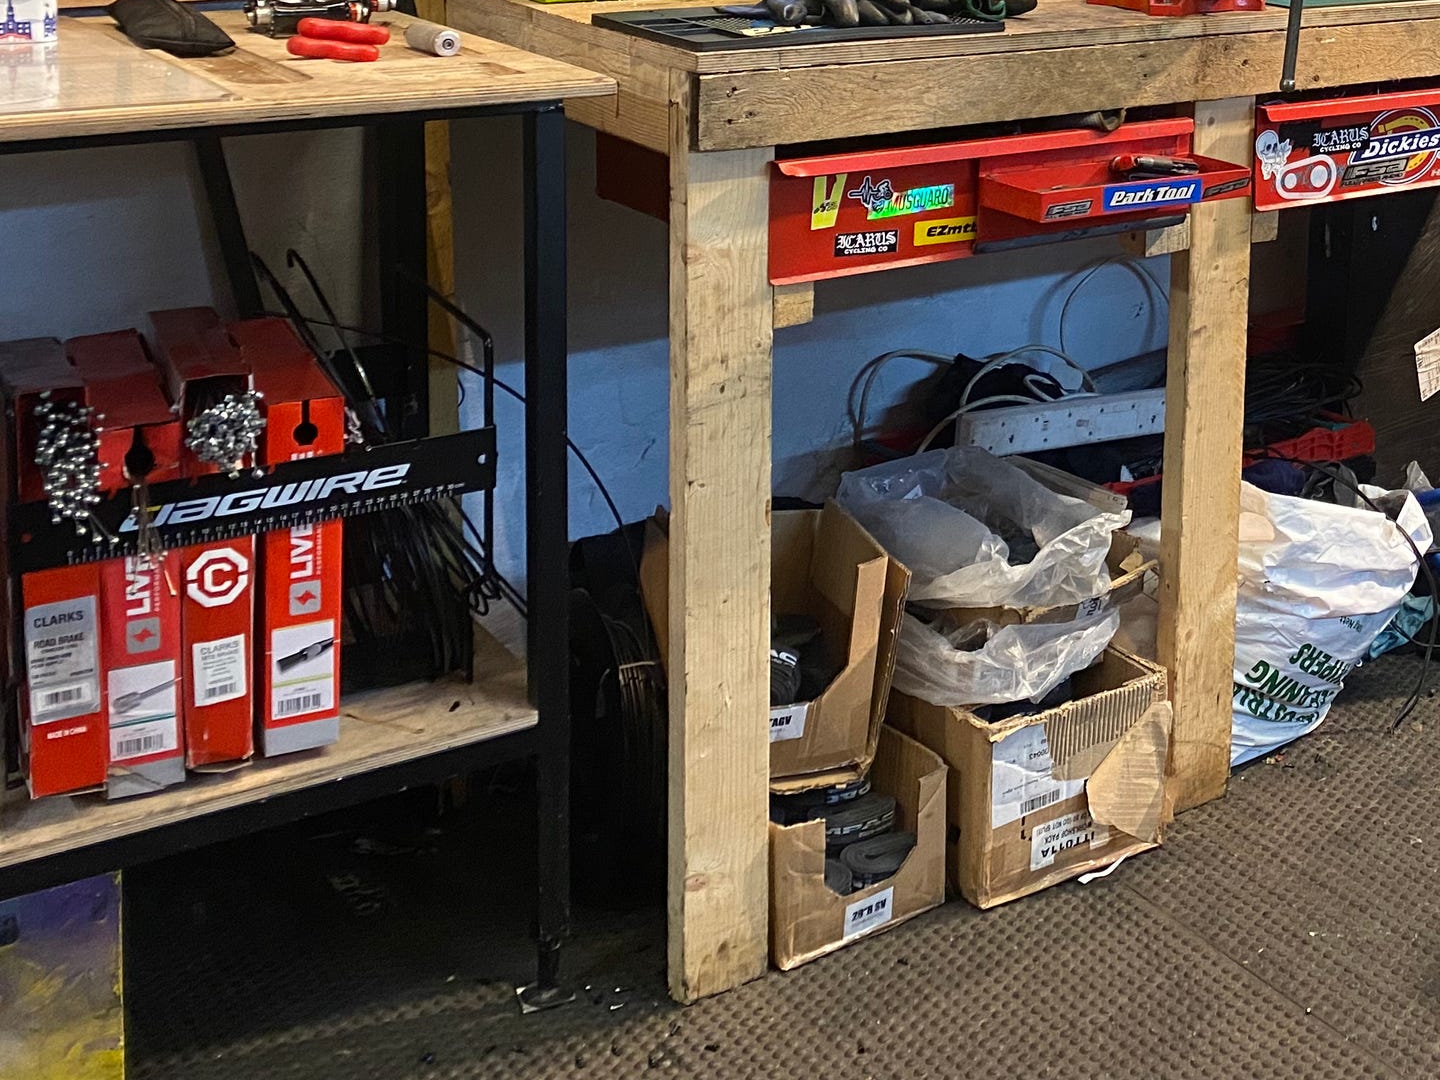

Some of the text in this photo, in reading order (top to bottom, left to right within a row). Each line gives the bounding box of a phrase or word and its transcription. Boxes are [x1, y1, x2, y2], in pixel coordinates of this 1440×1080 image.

[1312, 126, 1369, 148] ICARUS
[1320, 142, 1361, 153] CYCLING CO
[836, 231, 897, 250] ICARUS
[844, 245, 888, 255] CYCLING CO
[33, 610, 84, 629] CLARKS
[33, 632, 85, 649] ROAD BRAKE
[200, 640, 240, 656] CLARKS
[1044, 833, 1061, 846] PACK
